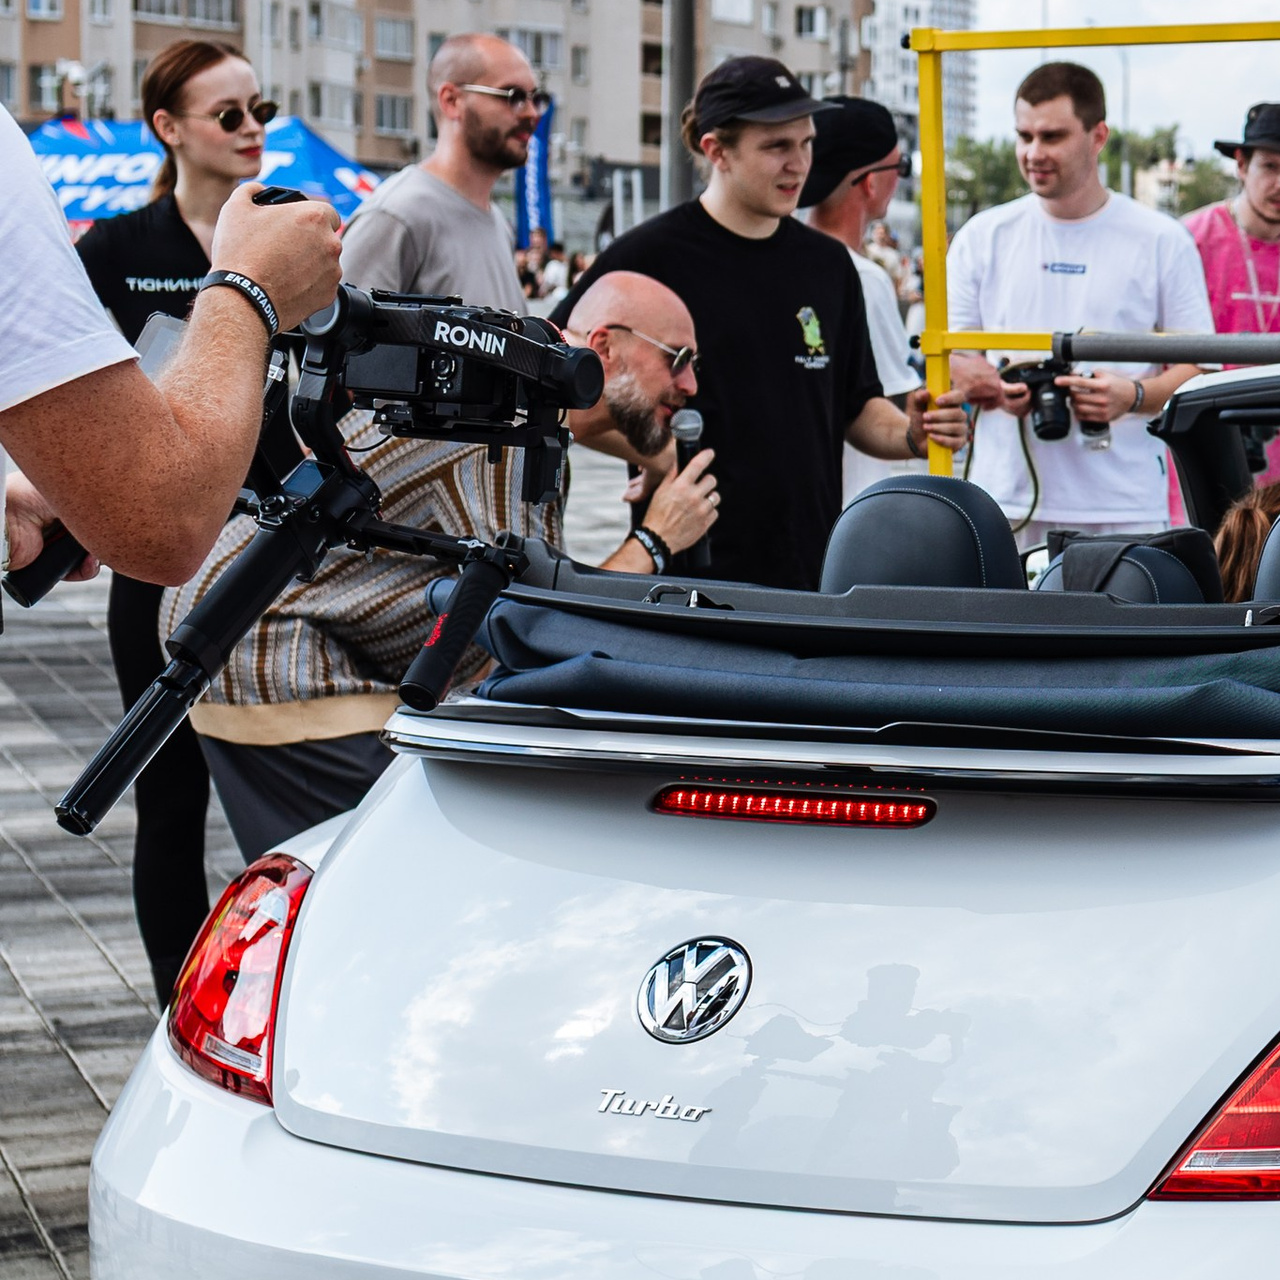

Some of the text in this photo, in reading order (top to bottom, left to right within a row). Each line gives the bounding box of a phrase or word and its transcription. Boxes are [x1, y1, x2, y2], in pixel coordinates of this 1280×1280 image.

[434, 321, 506, 357] RONIN
[642, 937, 750, 1042] VW
[598, 1088, 712, 1122] Turbo
